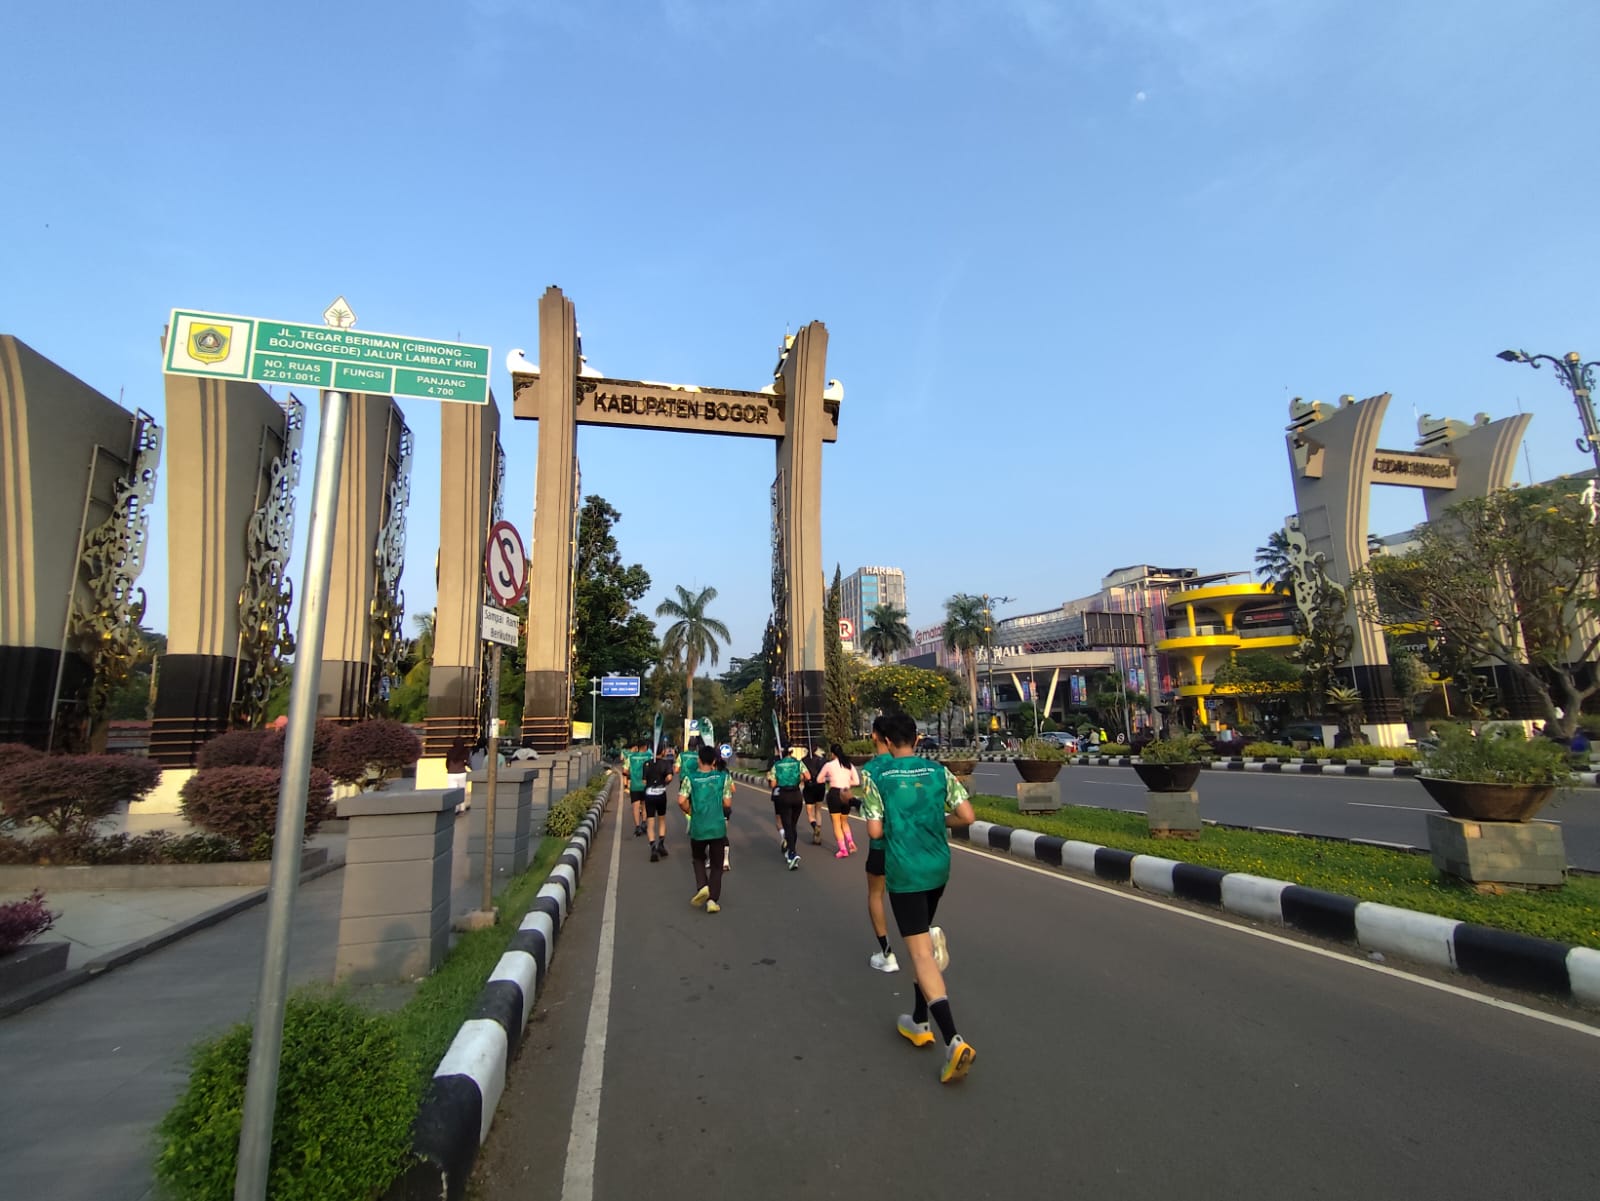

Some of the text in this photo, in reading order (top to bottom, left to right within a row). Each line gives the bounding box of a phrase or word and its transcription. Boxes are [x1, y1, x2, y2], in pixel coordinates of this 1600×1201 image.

[278, 328, 296, 337] JL.
[300, 330, 342, 342] TEGAR
[345, 335, 399, 349] BERIMAN
[402, 343, 462, 357] (CIBINONG
[269, 337, 477, 369] BOJONGGEDE) JALUR LAMBAT KIRI
[265, 360, 321, 372] NO. RUAS
[343, 367, 385, 379] FUNGSI
[416, 375, 466, 388] PANJANG
[427, 387, 454, 396] 4.700
[594, 392, 768, 424] KABUPATEN BOGOR
[865, 566, 903, 576] HARRIS
